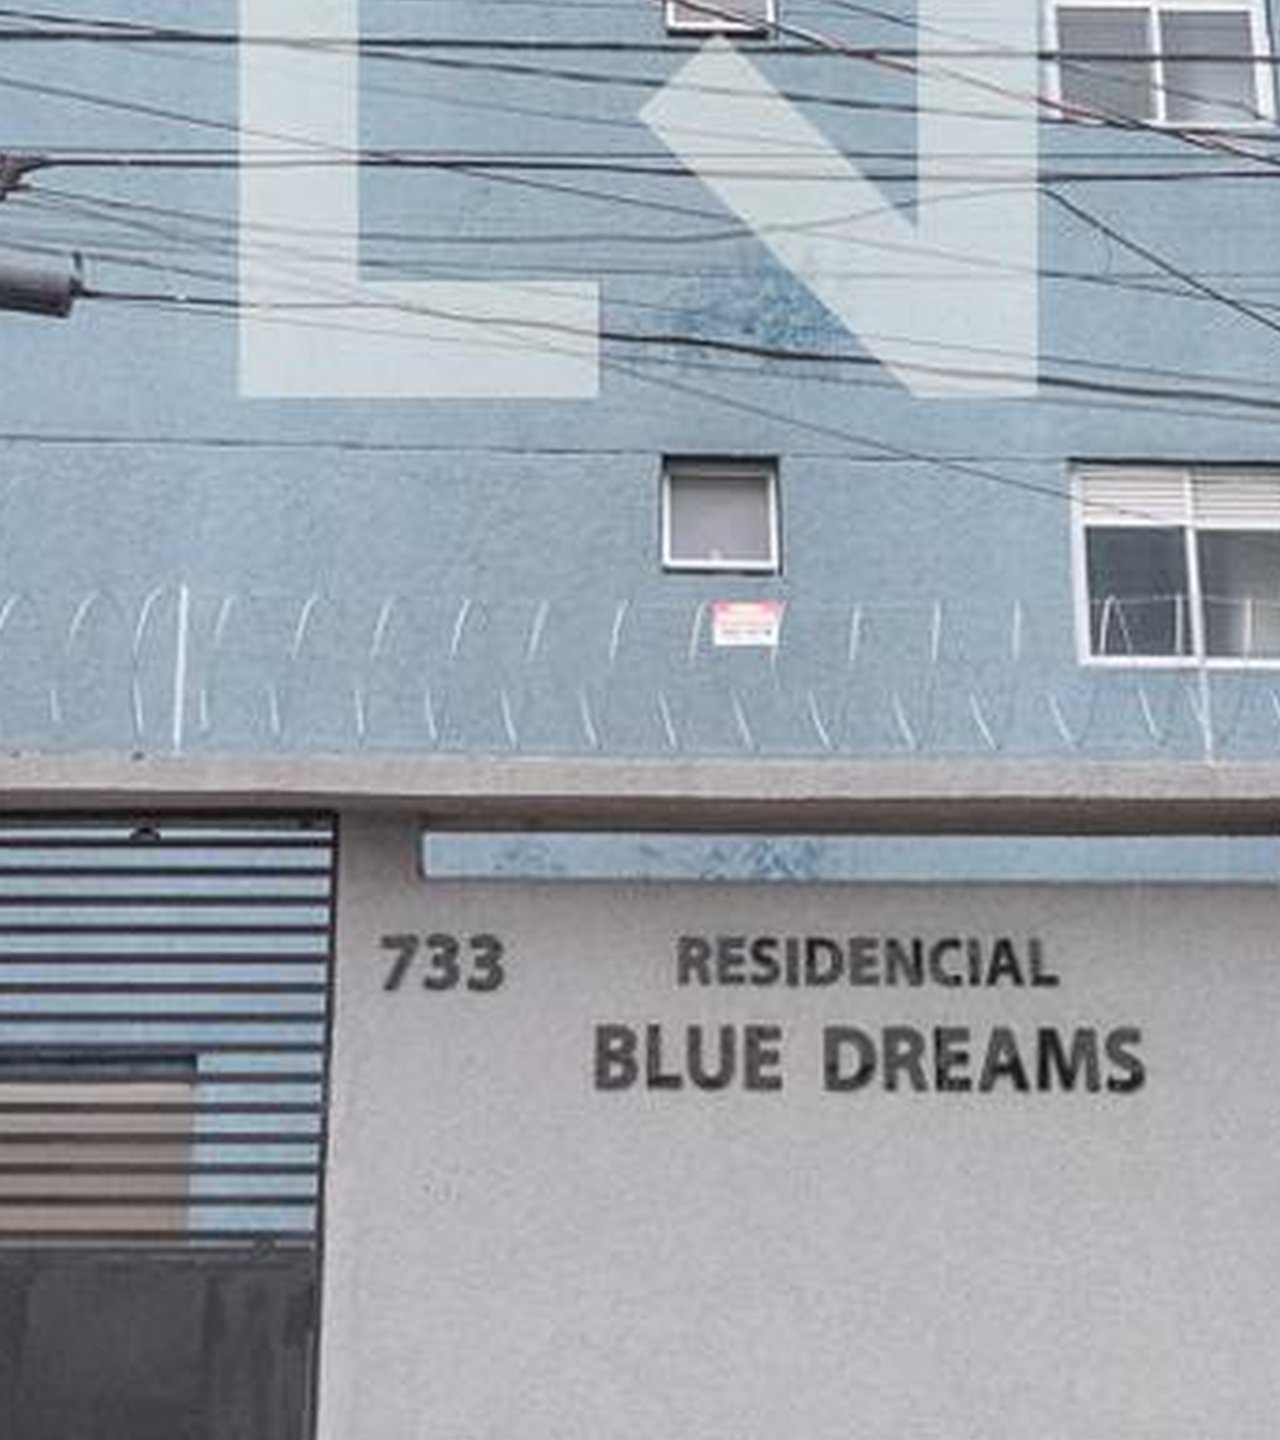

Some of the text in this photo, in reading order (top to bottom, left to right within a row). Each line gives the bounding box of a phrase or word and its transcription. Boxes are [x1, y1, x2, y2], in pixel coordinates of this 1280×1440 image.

[380, 933, 505, 991] 733
[677, 936, 1060, 987] RESIDENCIAL
[593, 1024, 1146, 1095] BLUE DREAMS
